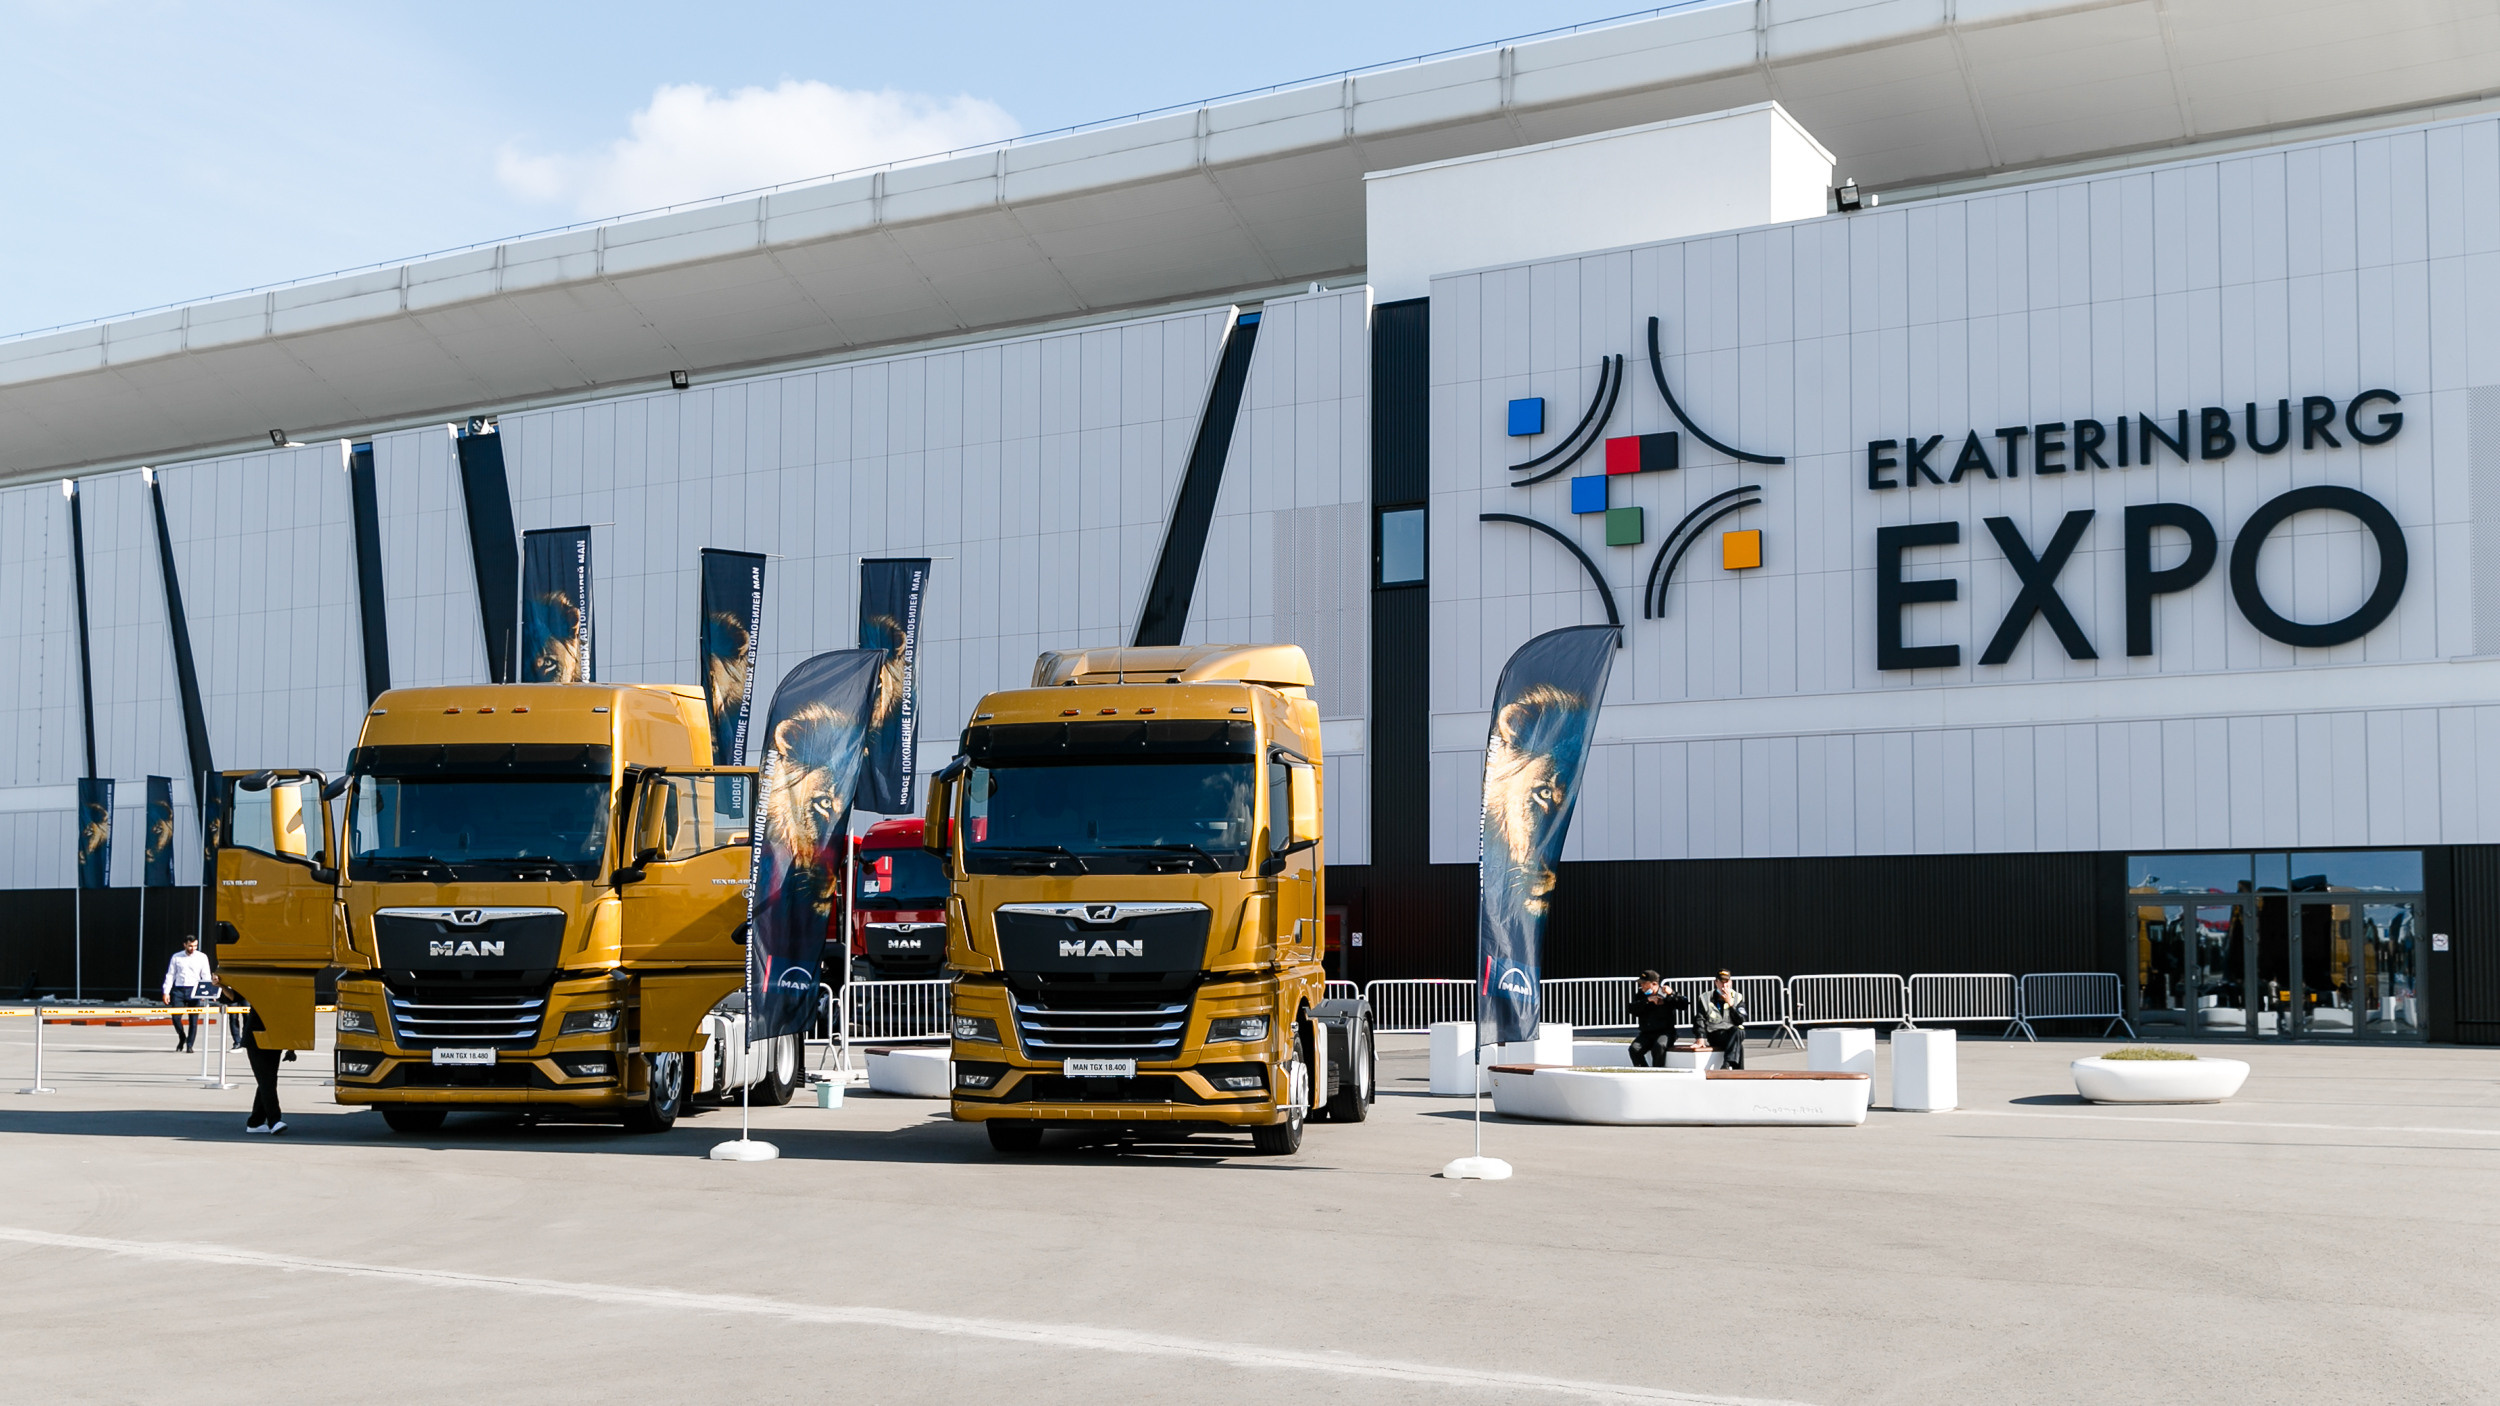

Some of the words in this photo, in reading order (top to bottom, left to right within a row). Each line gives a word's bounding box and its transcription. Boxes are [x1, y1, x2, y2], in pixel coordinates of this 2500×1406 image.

[1867, 389, 2404, 490] EKATERINBURG
[576, 540, 586, 563] MAN
[752, 567, 761, 589] MAN
[912, 571, 922, 591] MAN
[1876, 485, 2409, 671] EXPO
[576, 566, 587, 641] АВТОМОБИЛЕЙ
[747, 592, 761, 664] АВТОМОБИЛЕЙ
[905, 593, 918, 662] АВТОМОБИЛЕЙ
[581, 642, 591, 683] ЗОВЫХ
[740, 666, 754, 717] ГРУЗОВЫХ
[902, 665, 913, 715] ГРУЗОВЫХ
[902, 718, 912, 773] ПОКОЛЕНИЕ
[764, 750, 778, 776] MAN
[732, 776, 741, 809] НОВОЕ
[900, 775, 910, 805] НОВОЕ
[429, 941, 504, 956] MAN
[887, 940, 921, 949] MAN
[1059, 940, 1143, 957] MAN
[781, 980, 811, 990] MAN
[1502, 982, 1529, 996] MAN
